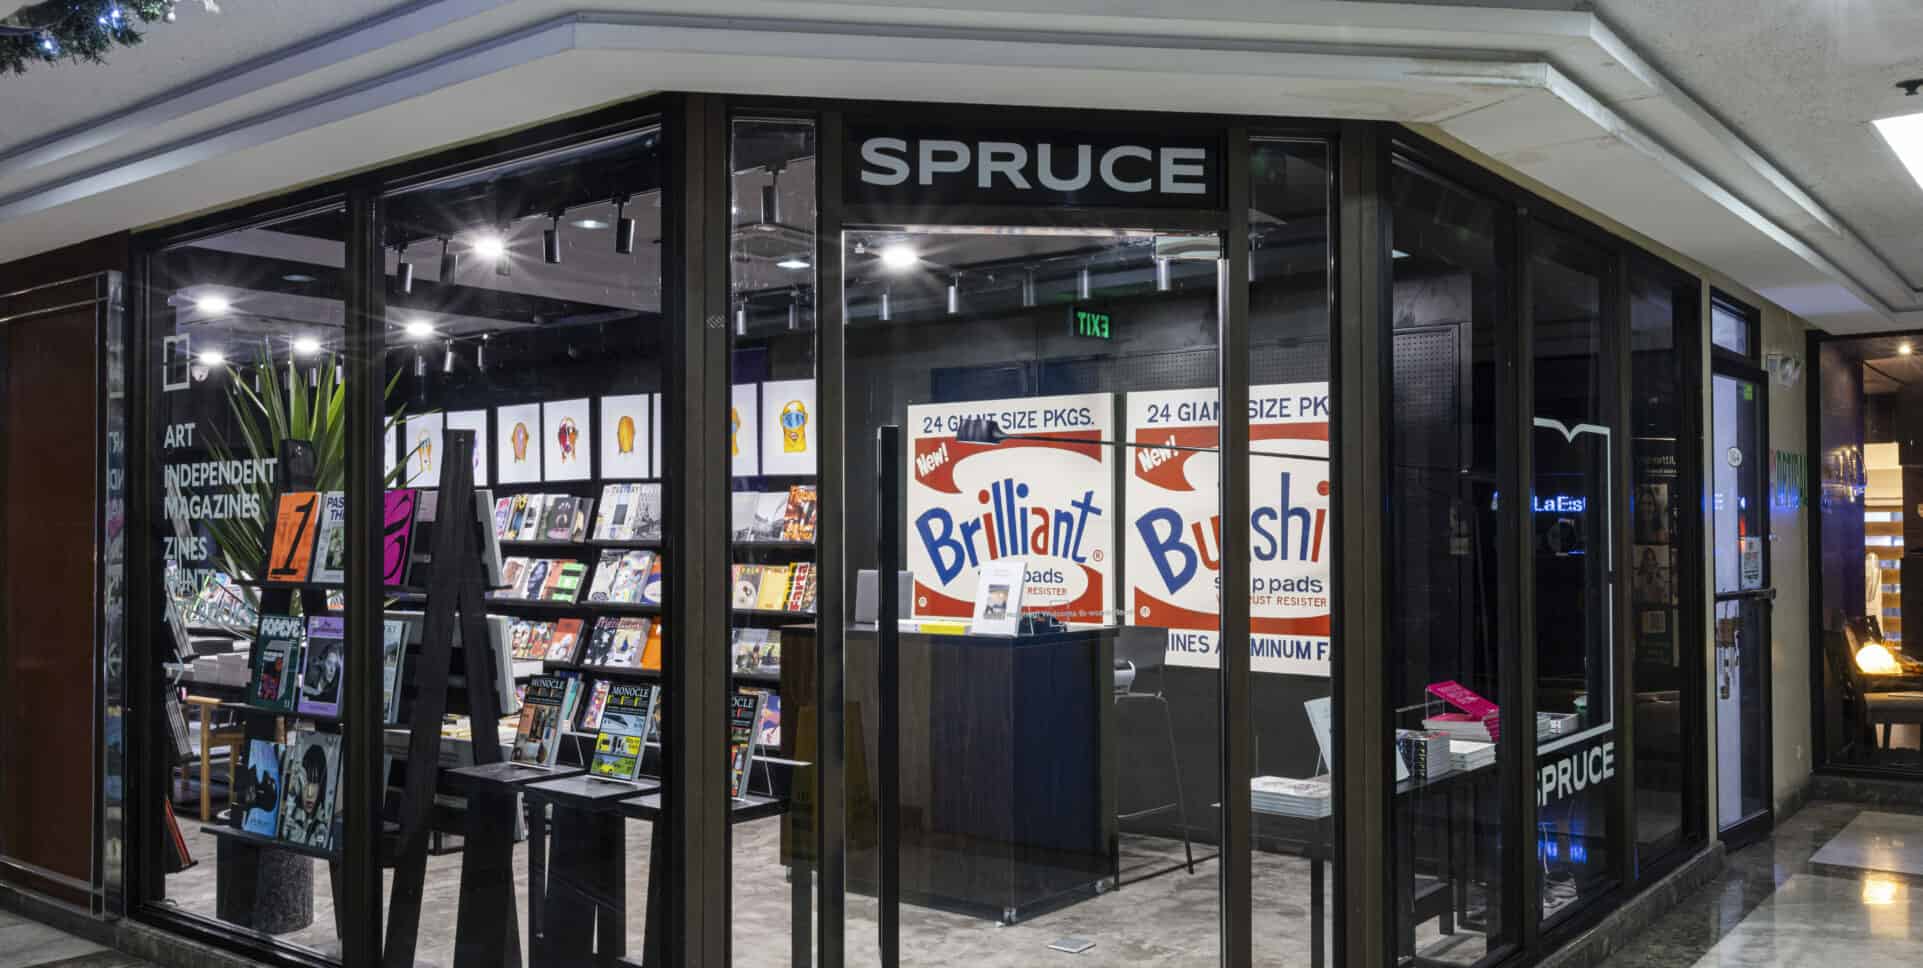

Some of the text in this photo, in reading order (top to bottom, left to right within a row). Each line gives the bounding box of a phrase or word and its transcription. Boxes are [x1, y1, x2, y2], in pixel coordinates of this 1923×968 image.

[860, 137, 1206, 194] SPRUCE
[923, 416, 943, 433] 24
[1001, 411, 1037, 429] SIZE
[1043, 408, 1095, 427] PKGS.
[1147, 395, 1329, 423] 24 GIA SIZE PK
[164, 422, 196, 448] ART
[916, 442, 949, 477] New!
[1137, 434, 1179, 472] New!
[164, 458, 278, 488] INDEPENDENT
[164, 493, 260, 520] MAGAZINES
[327, 496, 344, 508] PAS
[915, 478, 1102, 586] Brilliant
[163, 537, 208, 560] ZINES
[1269, 575, 1323, 593] pads
[1277, 595, 1327, 607] RESISTER
[1168, 633, 1210, 653] INES
[613, 686, 649, 698] MONOCLE
